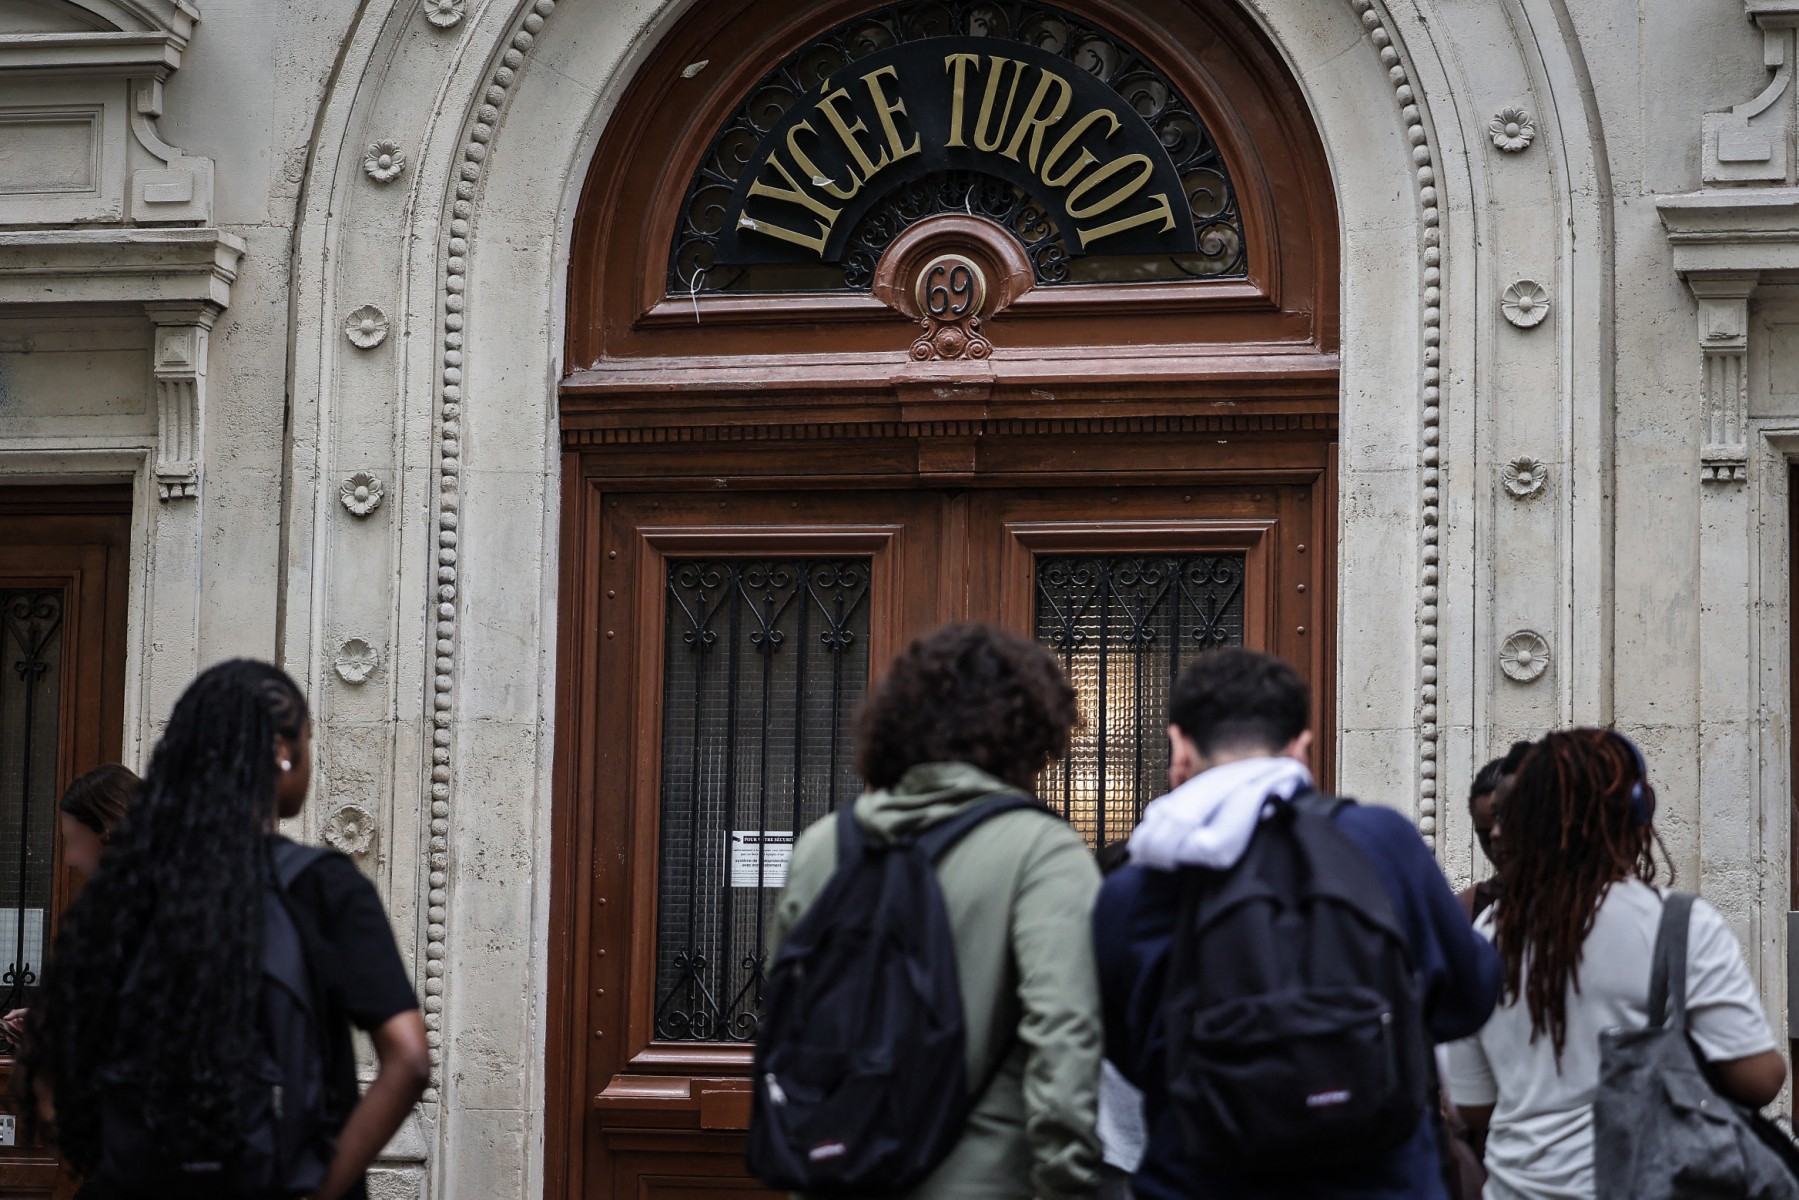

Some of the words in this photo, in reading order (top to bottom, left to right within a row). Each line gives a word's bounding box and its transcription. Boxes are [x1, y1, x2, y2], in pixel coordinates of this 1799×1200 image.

[736, 64, 922, 258] LYCÉE
[944, 53, 1177, 250] TURGOT
[925, 264, 975, 316] 69
